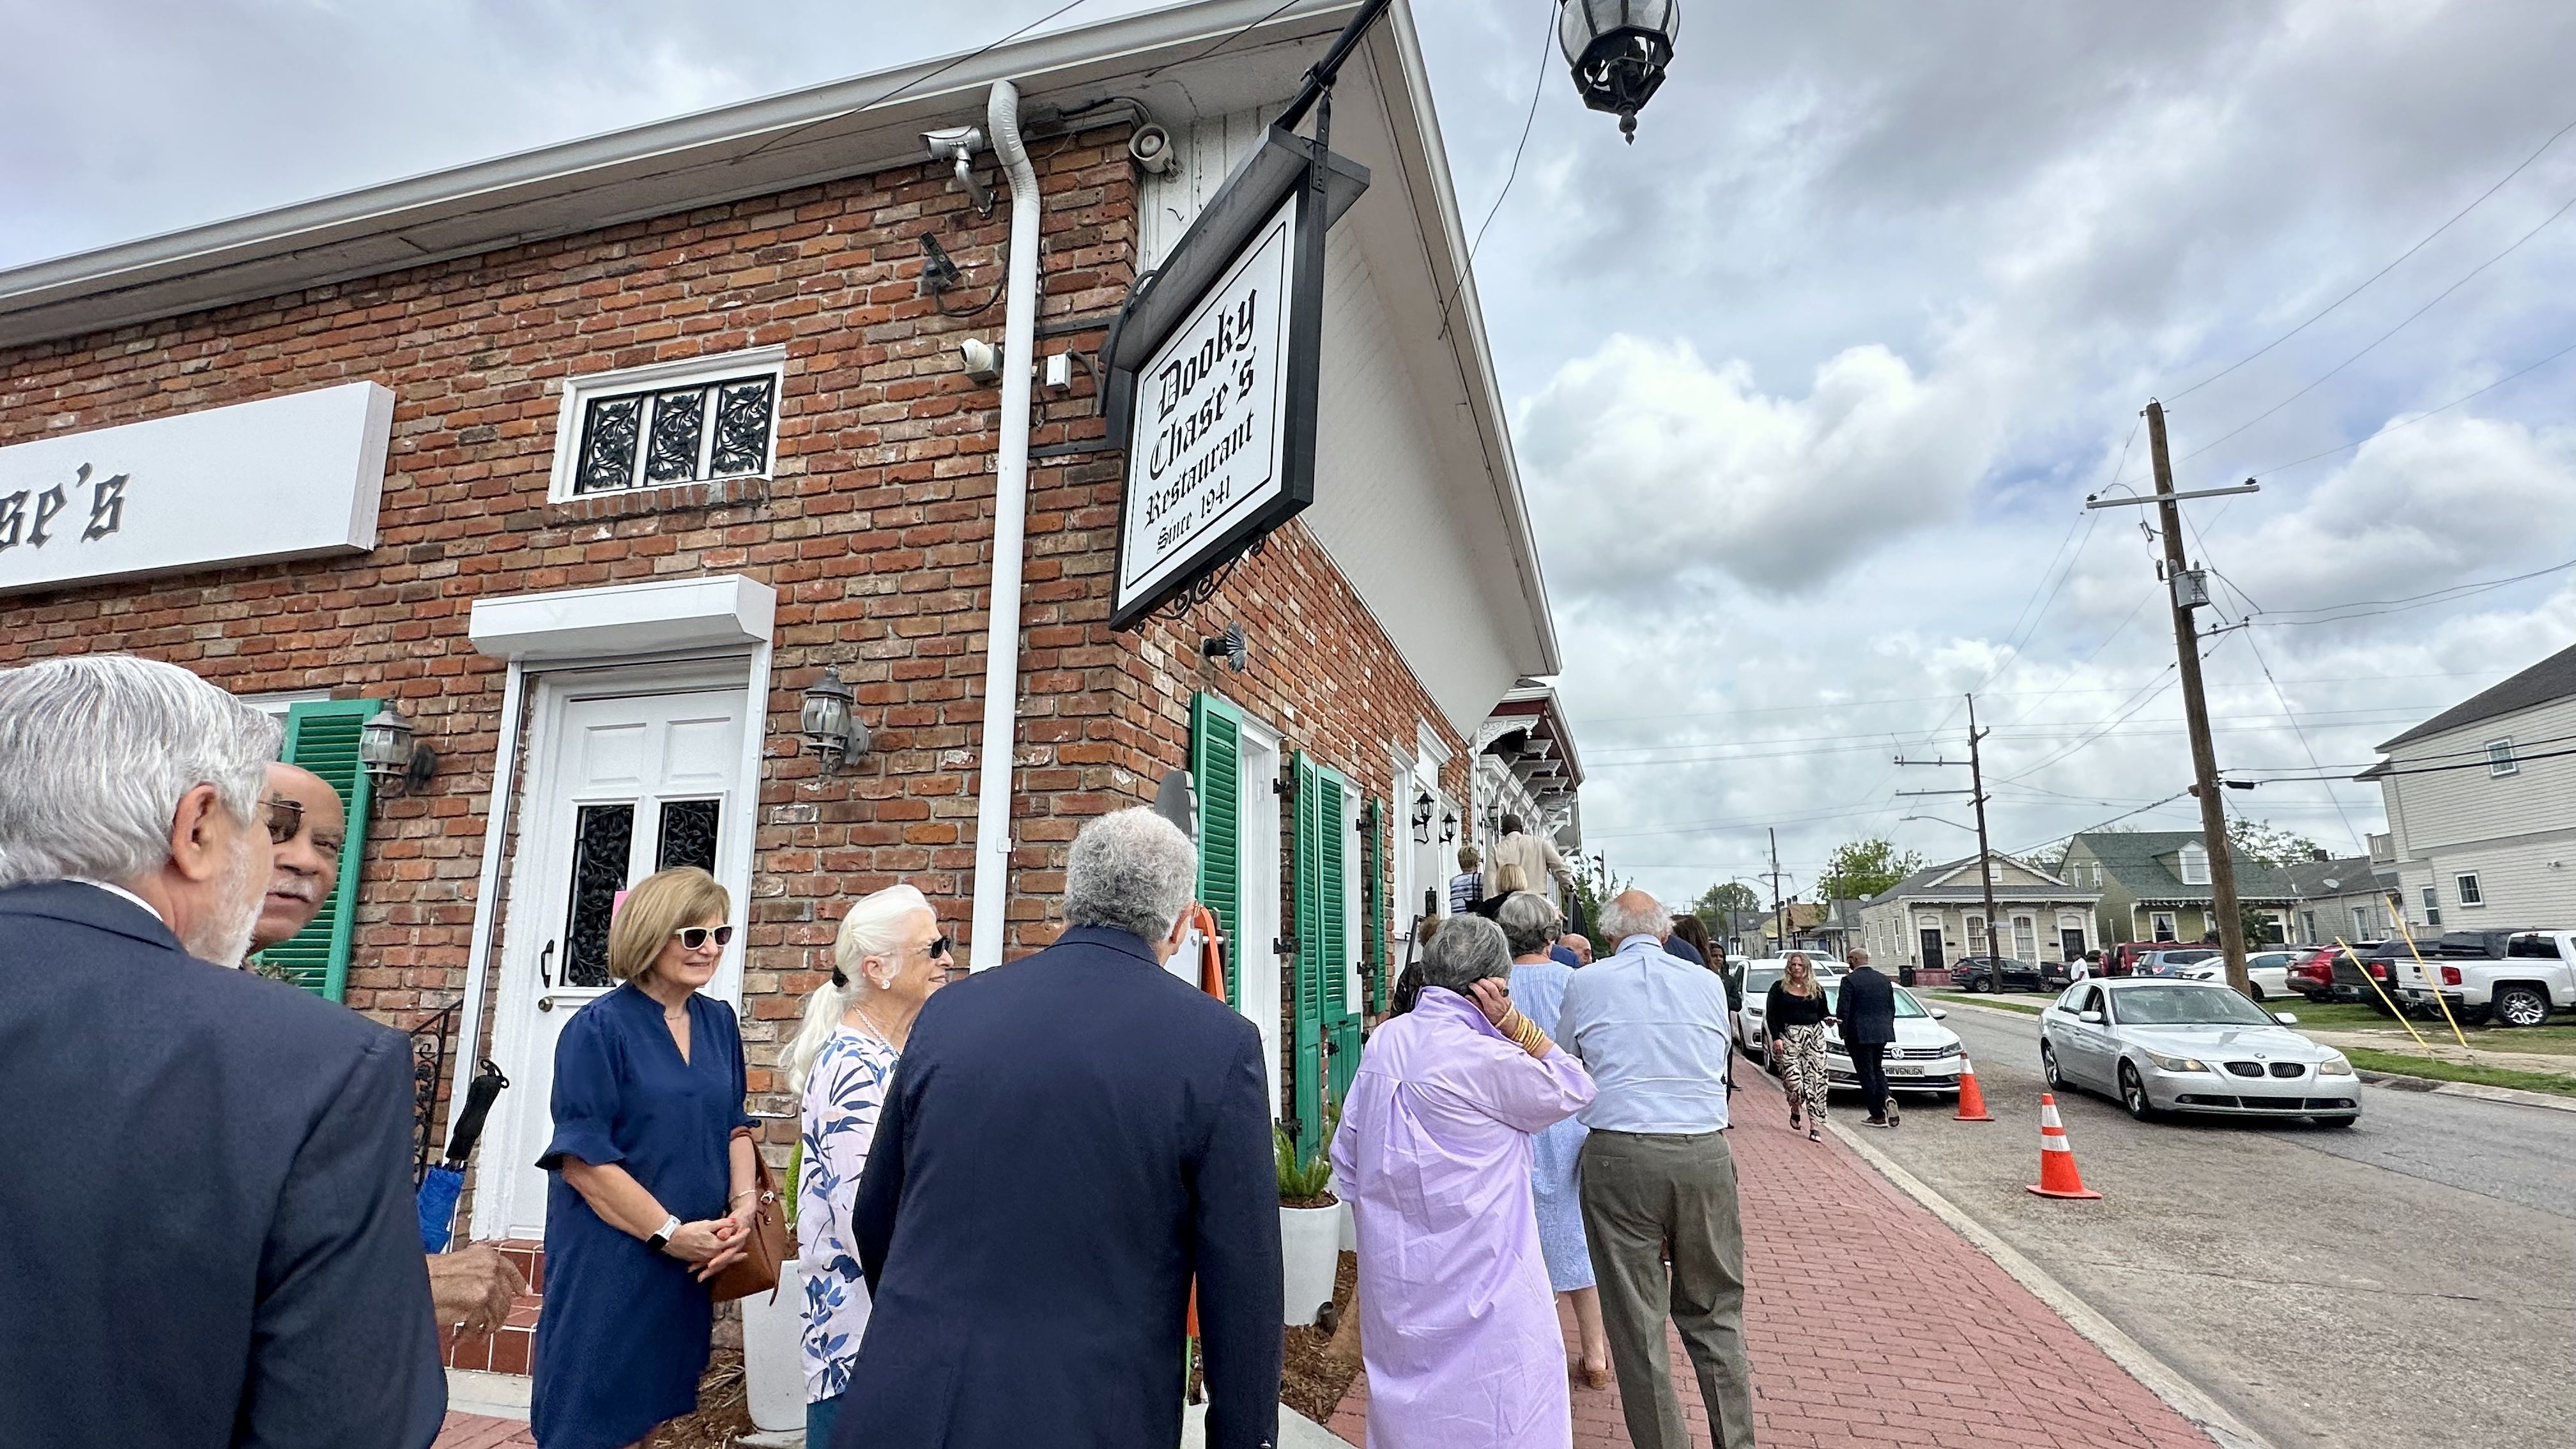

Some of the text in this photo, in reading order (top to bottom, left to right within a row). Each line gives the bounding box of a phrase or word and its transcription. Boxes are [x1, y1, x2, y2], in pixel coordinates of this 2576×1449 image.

[1149, 345, 1257, 481] Chase's
[1157, 288, 1257, 425] Dooky
[1144, 408, 1255, 532] Restaurant
[1156, 474, 1231, 555] Since 1941
